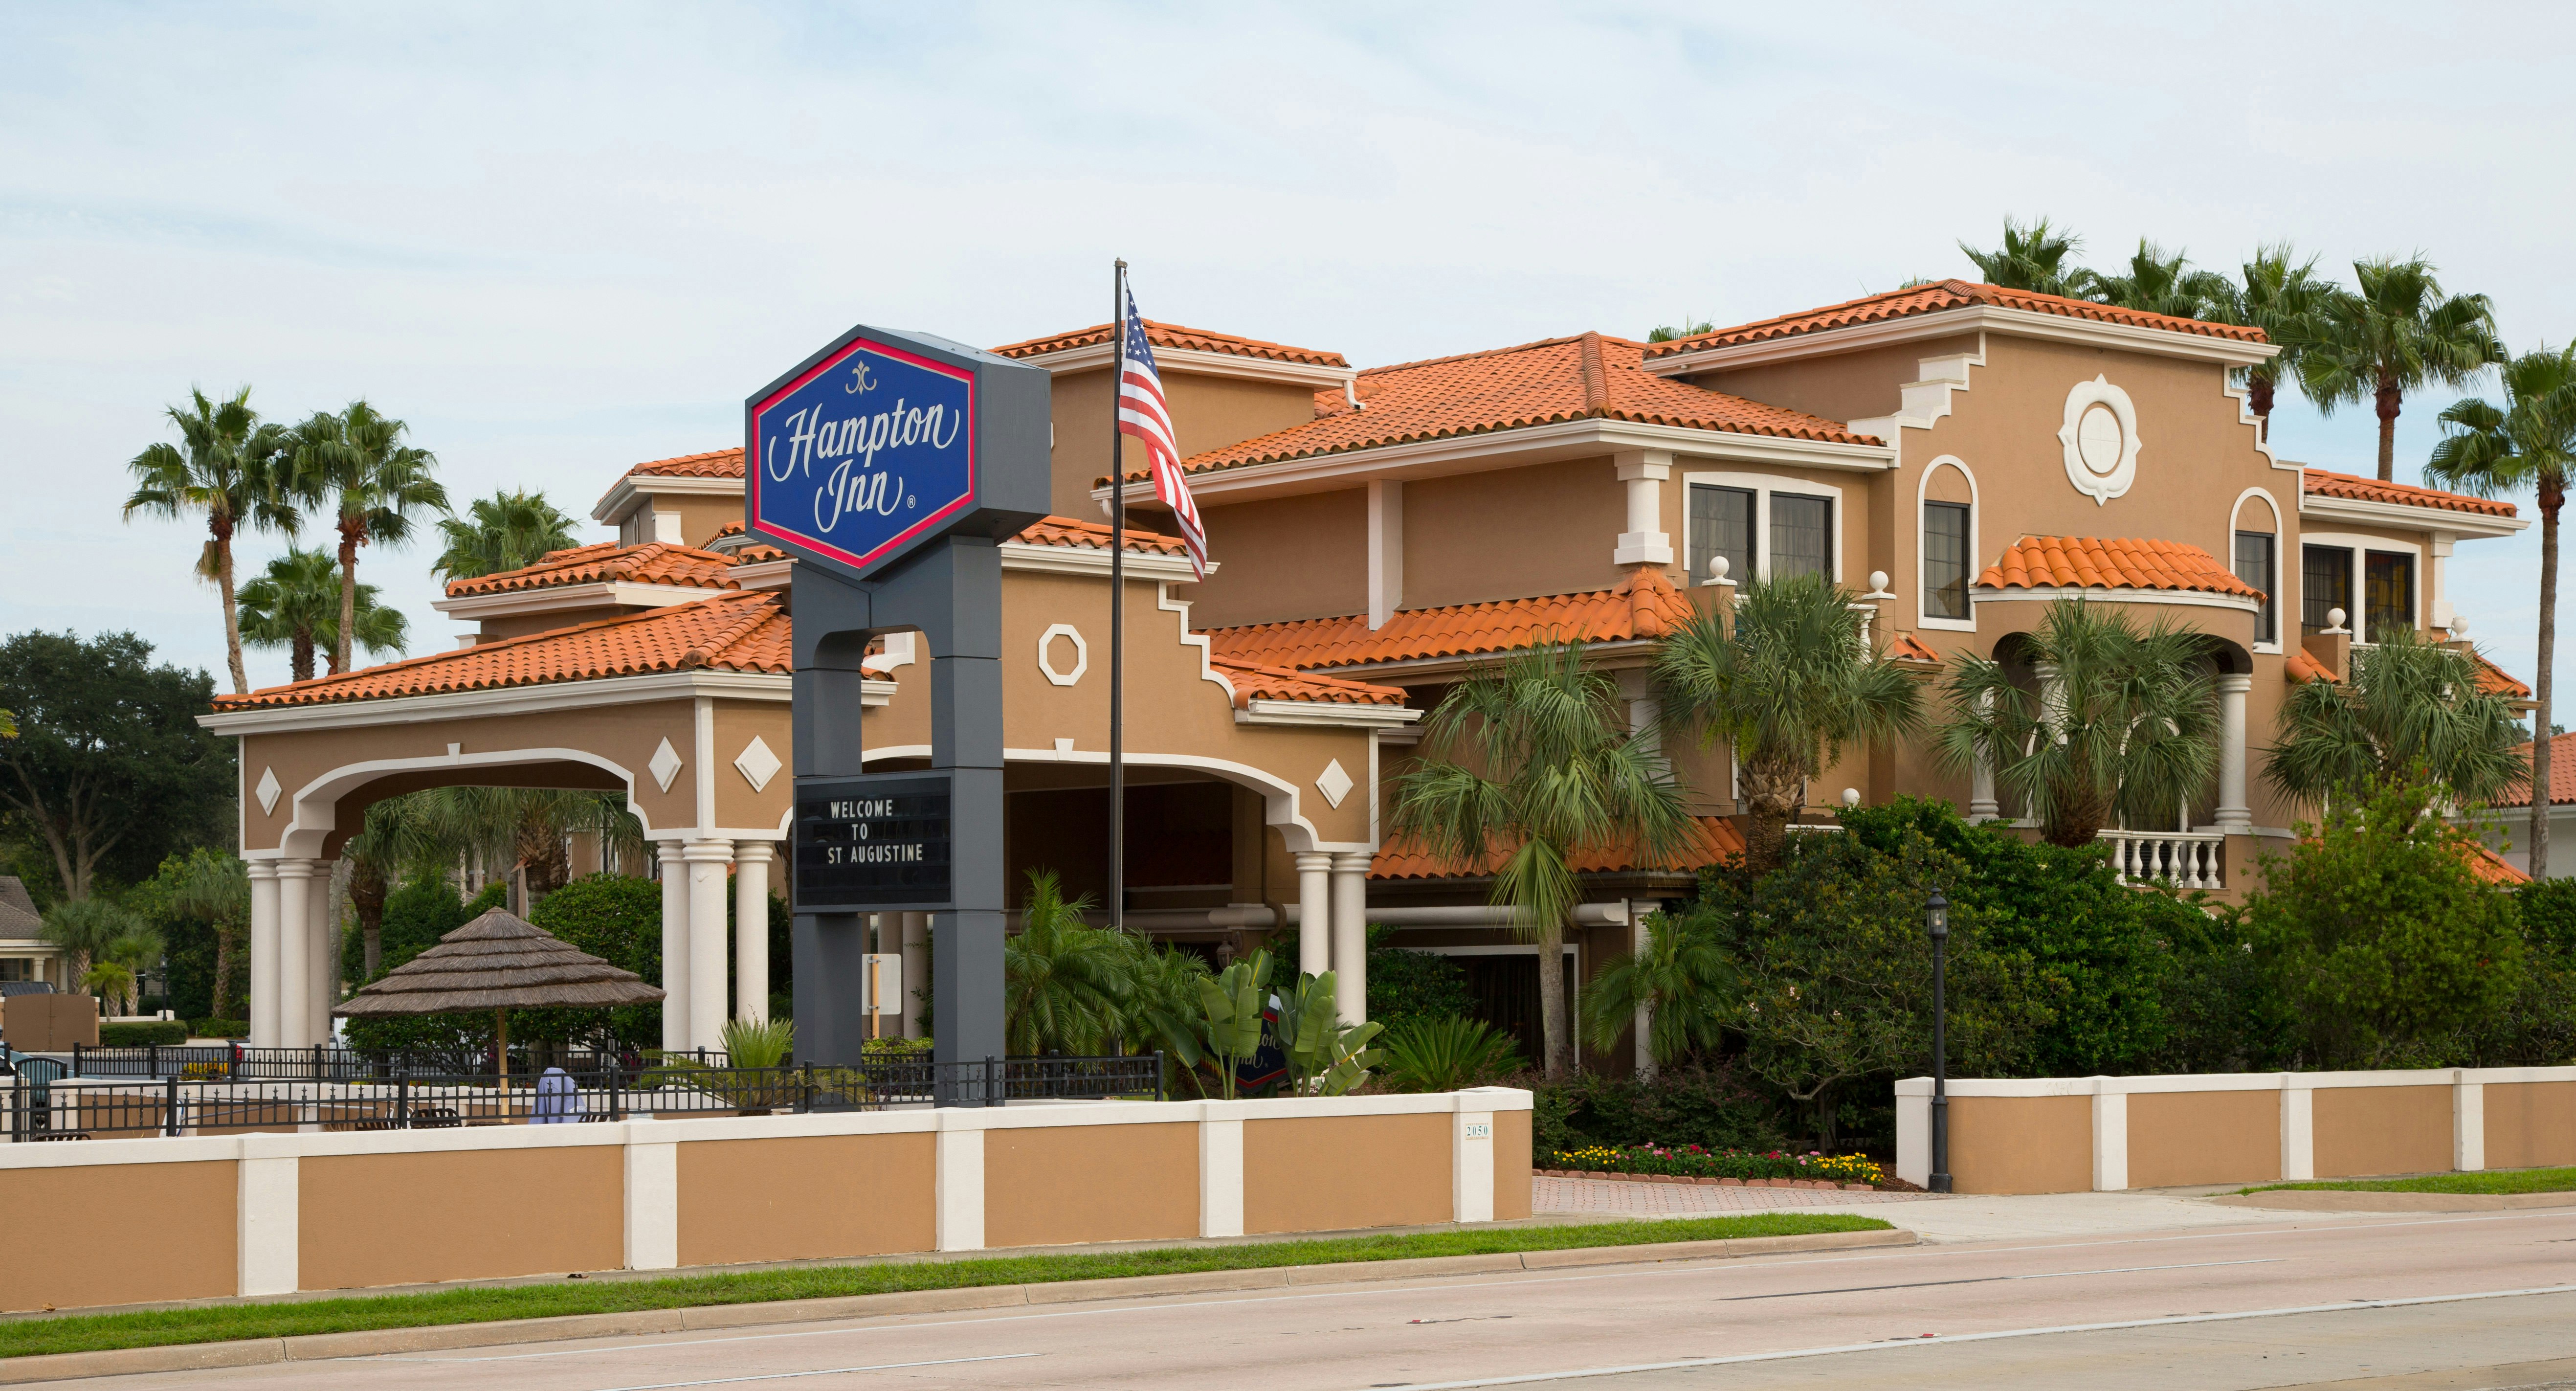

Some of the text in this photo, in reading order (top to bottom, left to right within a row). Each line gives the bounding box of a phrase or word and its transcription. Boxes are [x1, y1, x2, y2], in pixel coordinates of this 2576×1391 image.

[768, 398, 959, 482] Hampton
[814, 458, 903, 533] Inn
[830, 799, 892, 818] WELCOME
[851, 823, 868, 841] TO
[828, 844, 923, 864] ST AUGUSTINE
[1466, 1125, 1488, 1136] 2050
